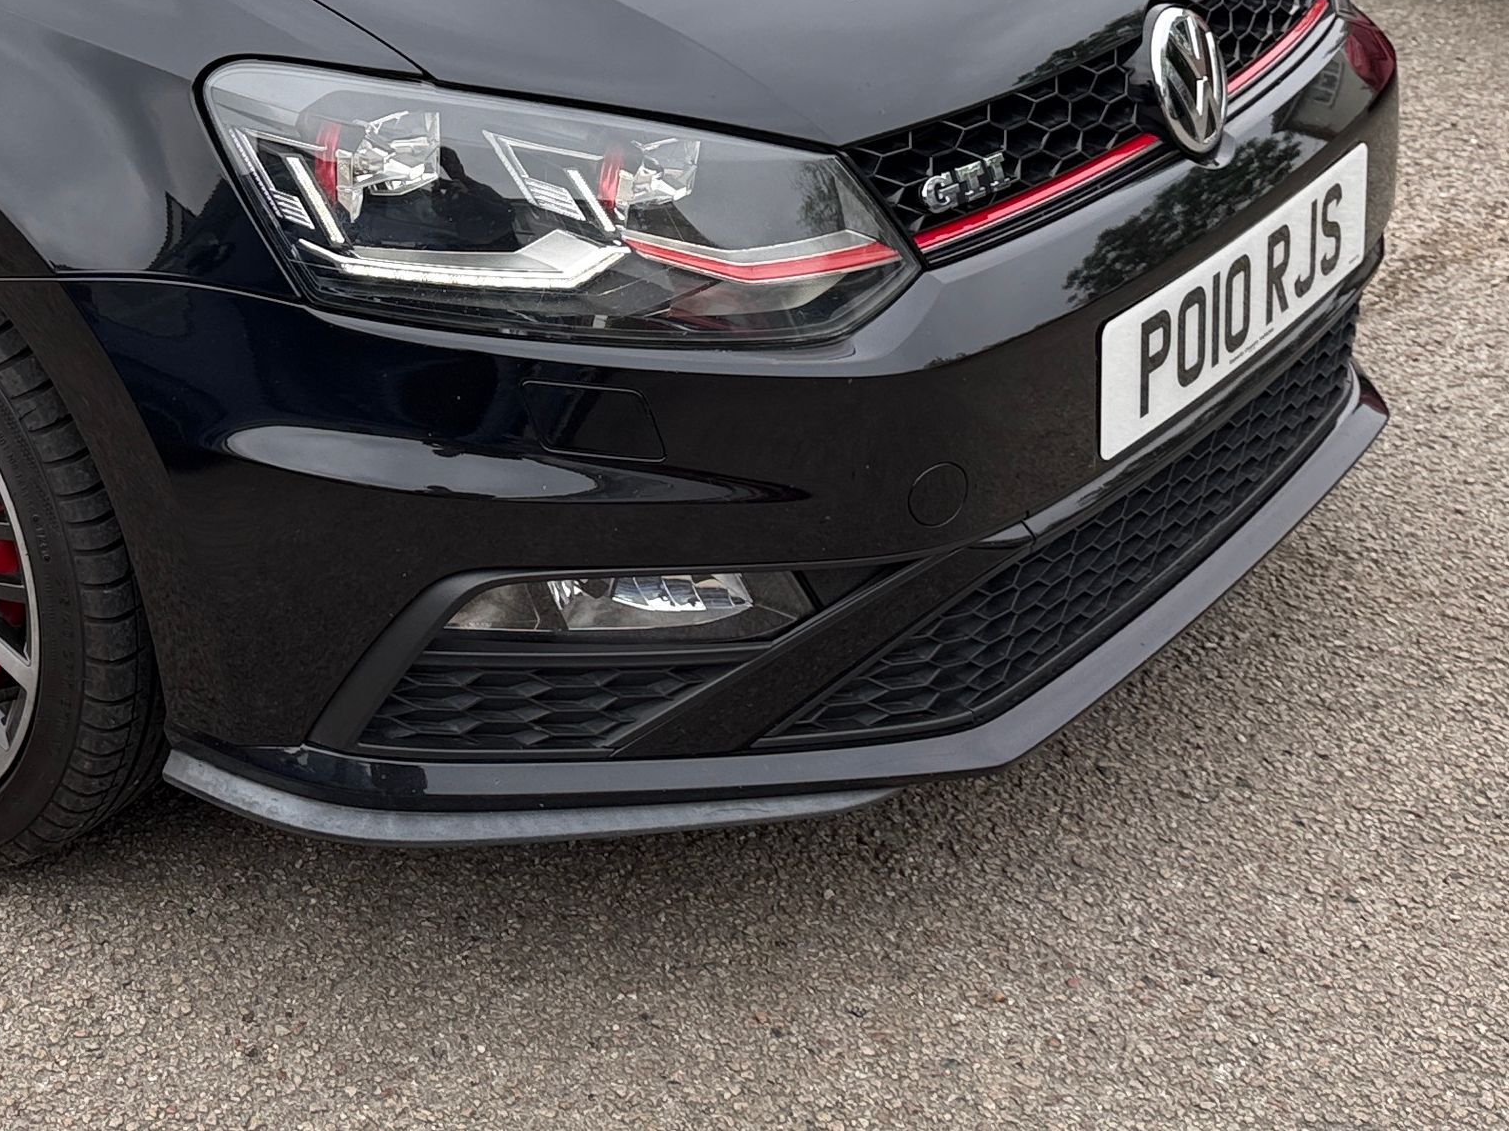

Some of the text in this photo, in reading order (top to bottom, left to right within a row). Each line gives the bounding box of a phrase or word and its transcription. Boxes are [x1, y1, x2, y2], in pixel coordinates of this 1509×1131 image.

[921, 152, 1011, 214] GTI
[1140, 183, 1343, 419] PO10 RJS
